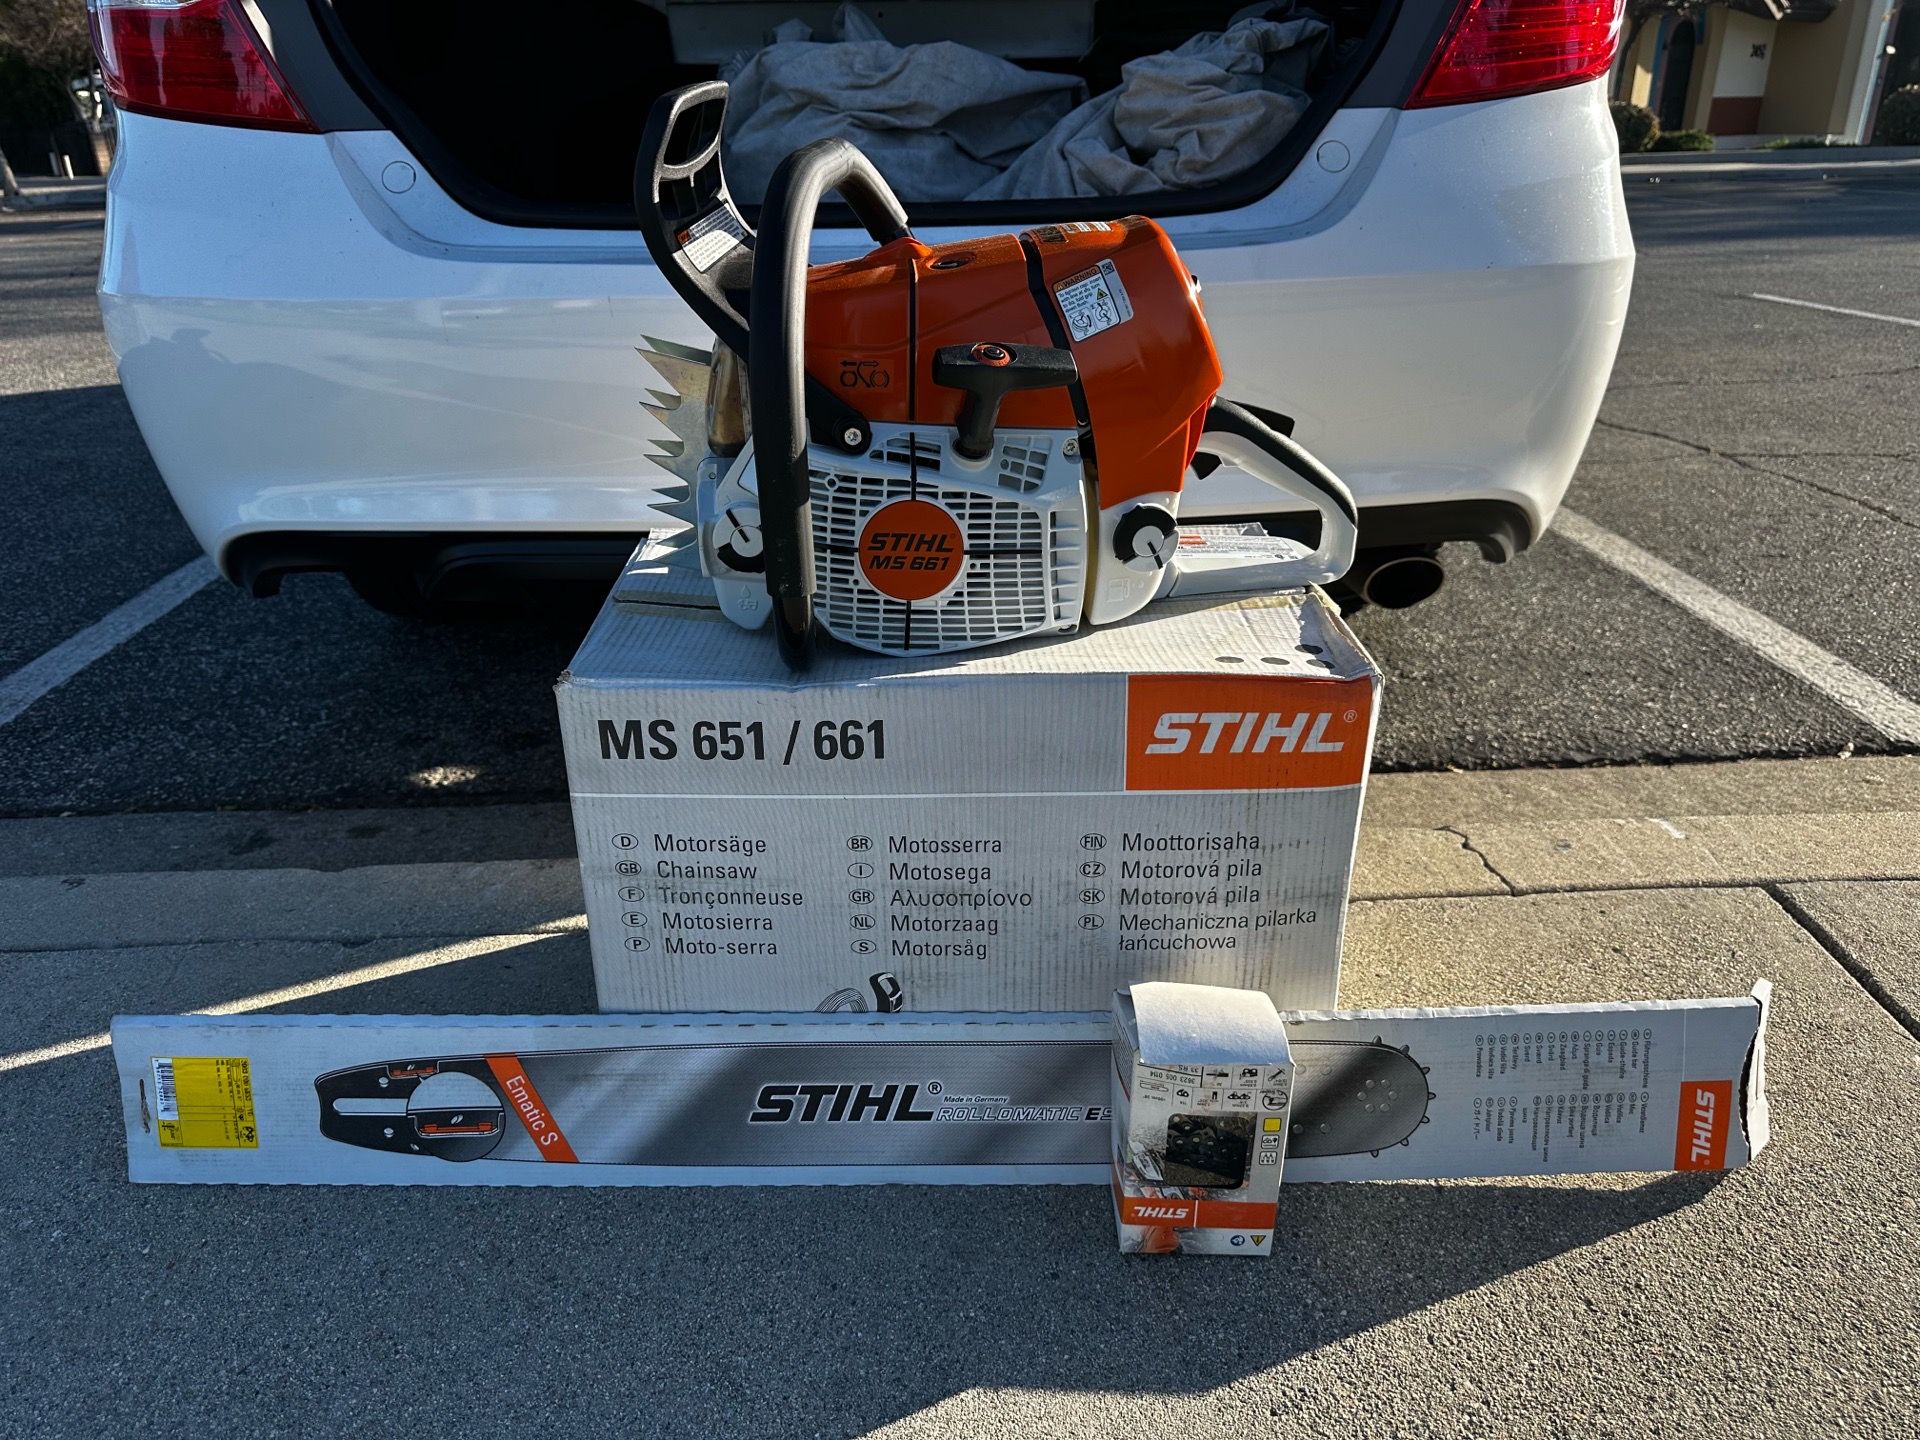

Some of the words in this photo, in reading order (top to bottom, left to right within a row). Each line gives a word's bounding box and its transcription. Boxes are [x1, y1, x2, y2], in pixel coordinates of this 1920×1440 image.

[1063, 269, 1097, 286] WARNING
[867, 532, 954, 552] STIHL
[869, 556, 907, 570] MS
[910, 556, 949, 570] 661
[598, 719, 678, 760] MS
[692, 720, 765, 760] 651
[783, 720, 801, 765] /
[814, 719, 884, 760] 661
[654, 834, 766, 857] Motorsäge
[889, 836, 1002, 853] Motosserra
[1122, 832, 1260, 851] Moottorisaha
[657, 860, 757, 879] Chainsaw
[889, 863, 991, 884] Motosega
[1121, 860, 1219, 879] Motorová
[1227, 859, 1262, 881] pila
[658, 887, 803, 909] Tronçonneuse
[890, 889, 1032, 910] Αλυσοπρίονο
[1120, 887, 1218, 906] Motorová
[1225, 886, 1260, 907] pila
[662, 912, 773, 930] Motosierra
[891, 915, 999, 935] Motorzaag
[1119, 913, 1249, 931] Mechaniczna
[1255, 908, 1317, 931] pilarka
[665, 938, 777, 955] Moto-serra
[892, 939, 987, 960] Motorsåg
[1119, 934, 1236, 951] łańcuchowa
[506, 1075, 547, 1133] Ematic
[540, 1132, 558, 1146] S
[936, 1106, 1083, 1121] ROLLOMATIC
[1690, 1088, 1715, 1162] STIHL
[1134, 1207, 1189, 1218] STIHL
